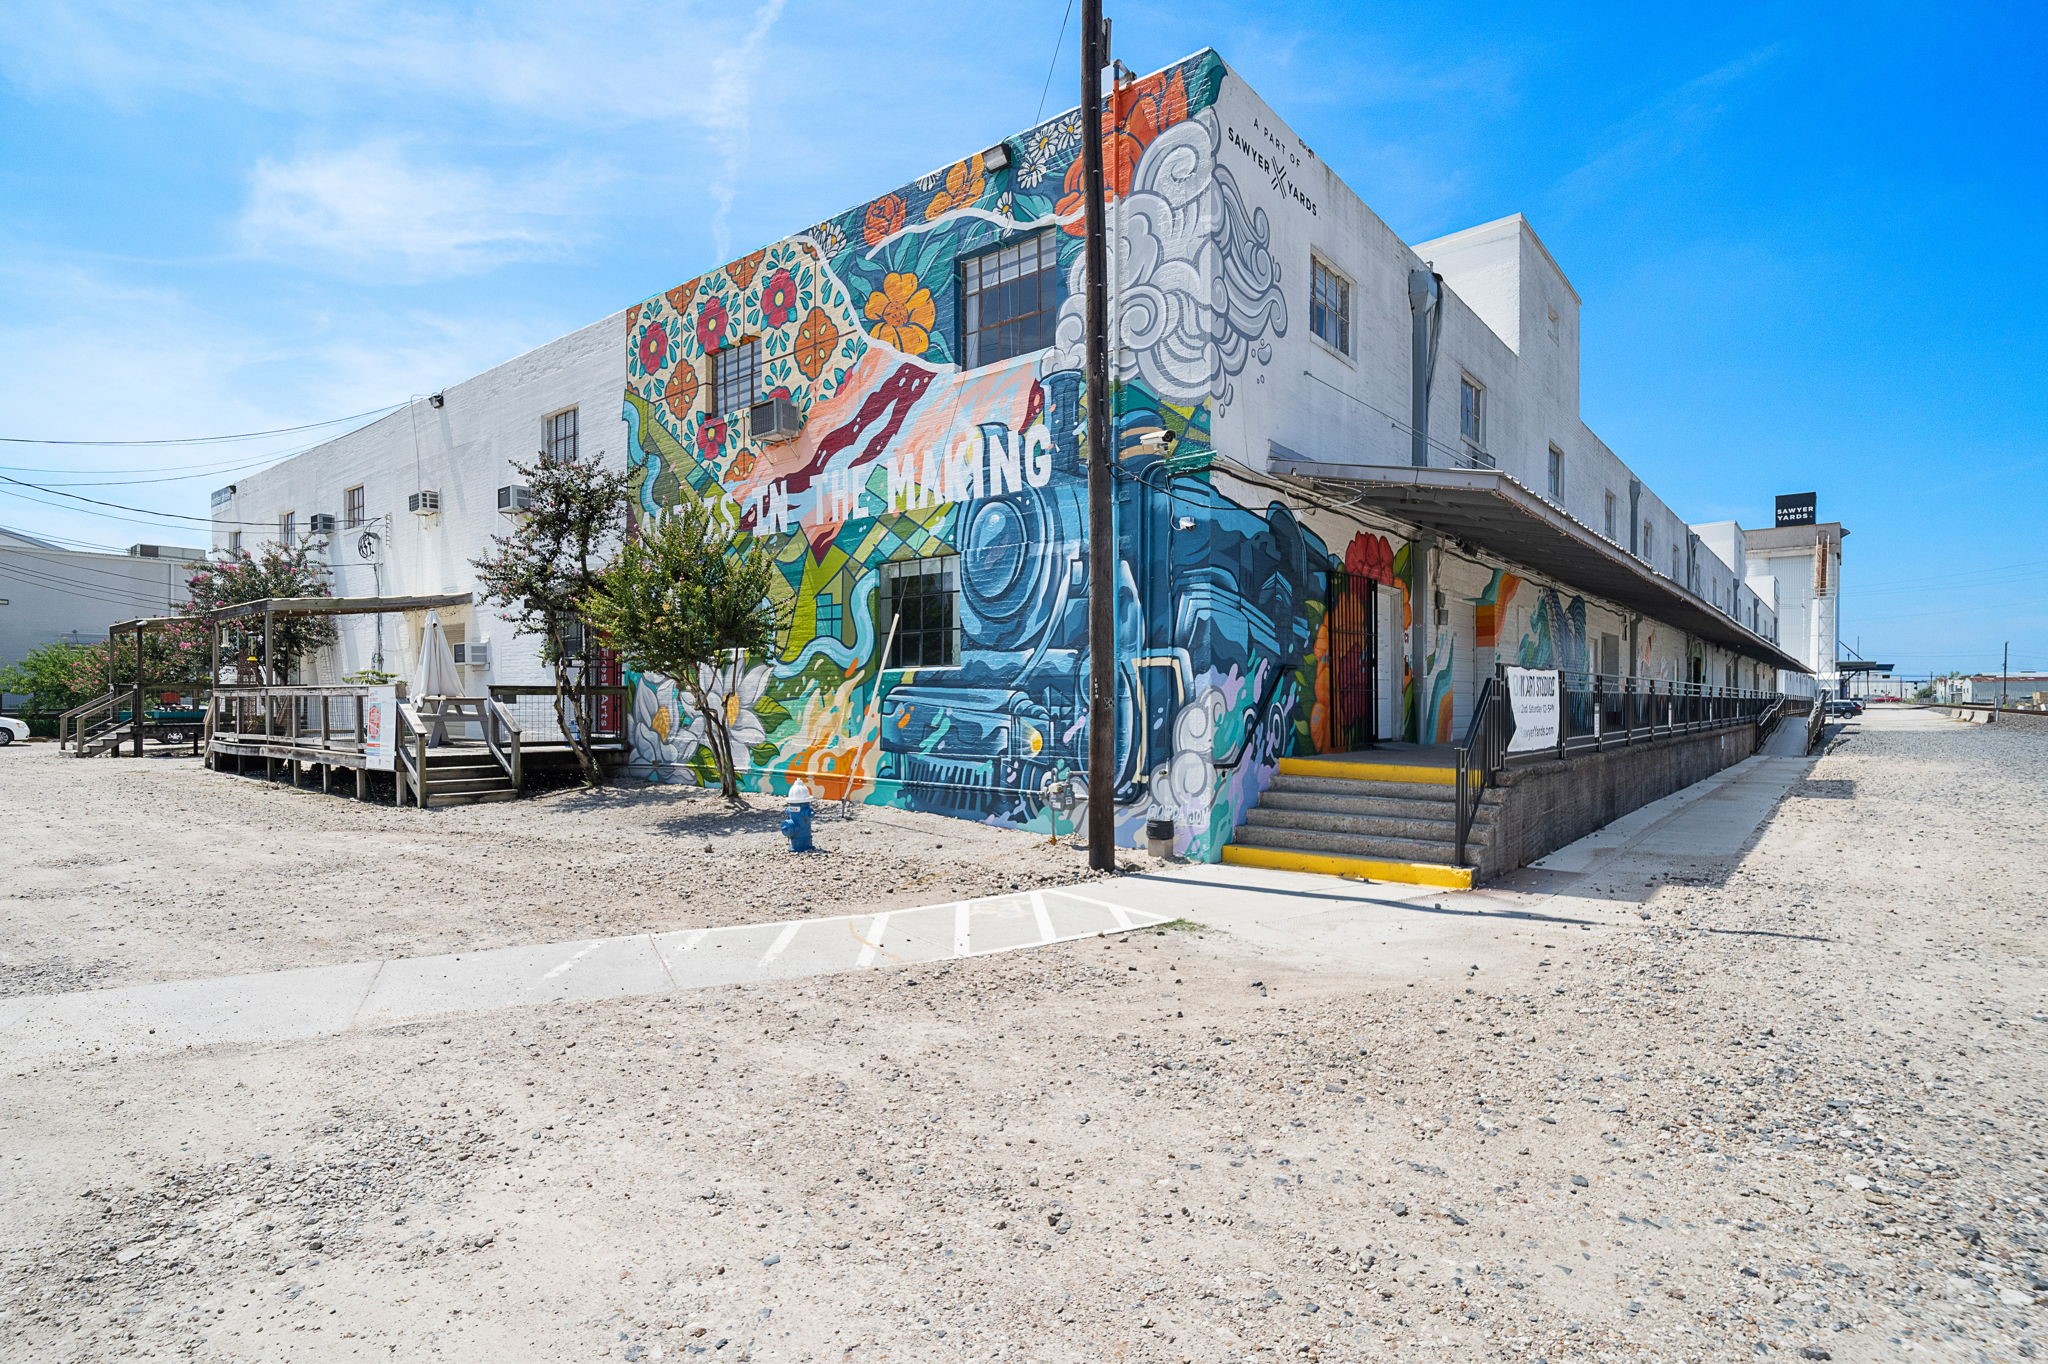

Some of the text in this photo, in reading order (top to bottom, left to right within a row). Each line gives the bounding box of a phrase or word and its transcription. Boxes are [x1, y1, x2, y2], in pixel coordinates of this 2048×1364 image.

[1253, 118, 1301, 168] A PART OF
[1228, 127, 1317, 216] SAWYER YARDS
[751, 481, 788, 537] IN
[809, 467, 870, 525] THE
[886, 423, 1052, 510] MAKING
[1777, 506, 1814, 515] SAWYER
[1777, 513, 1808, 521] YARDS
